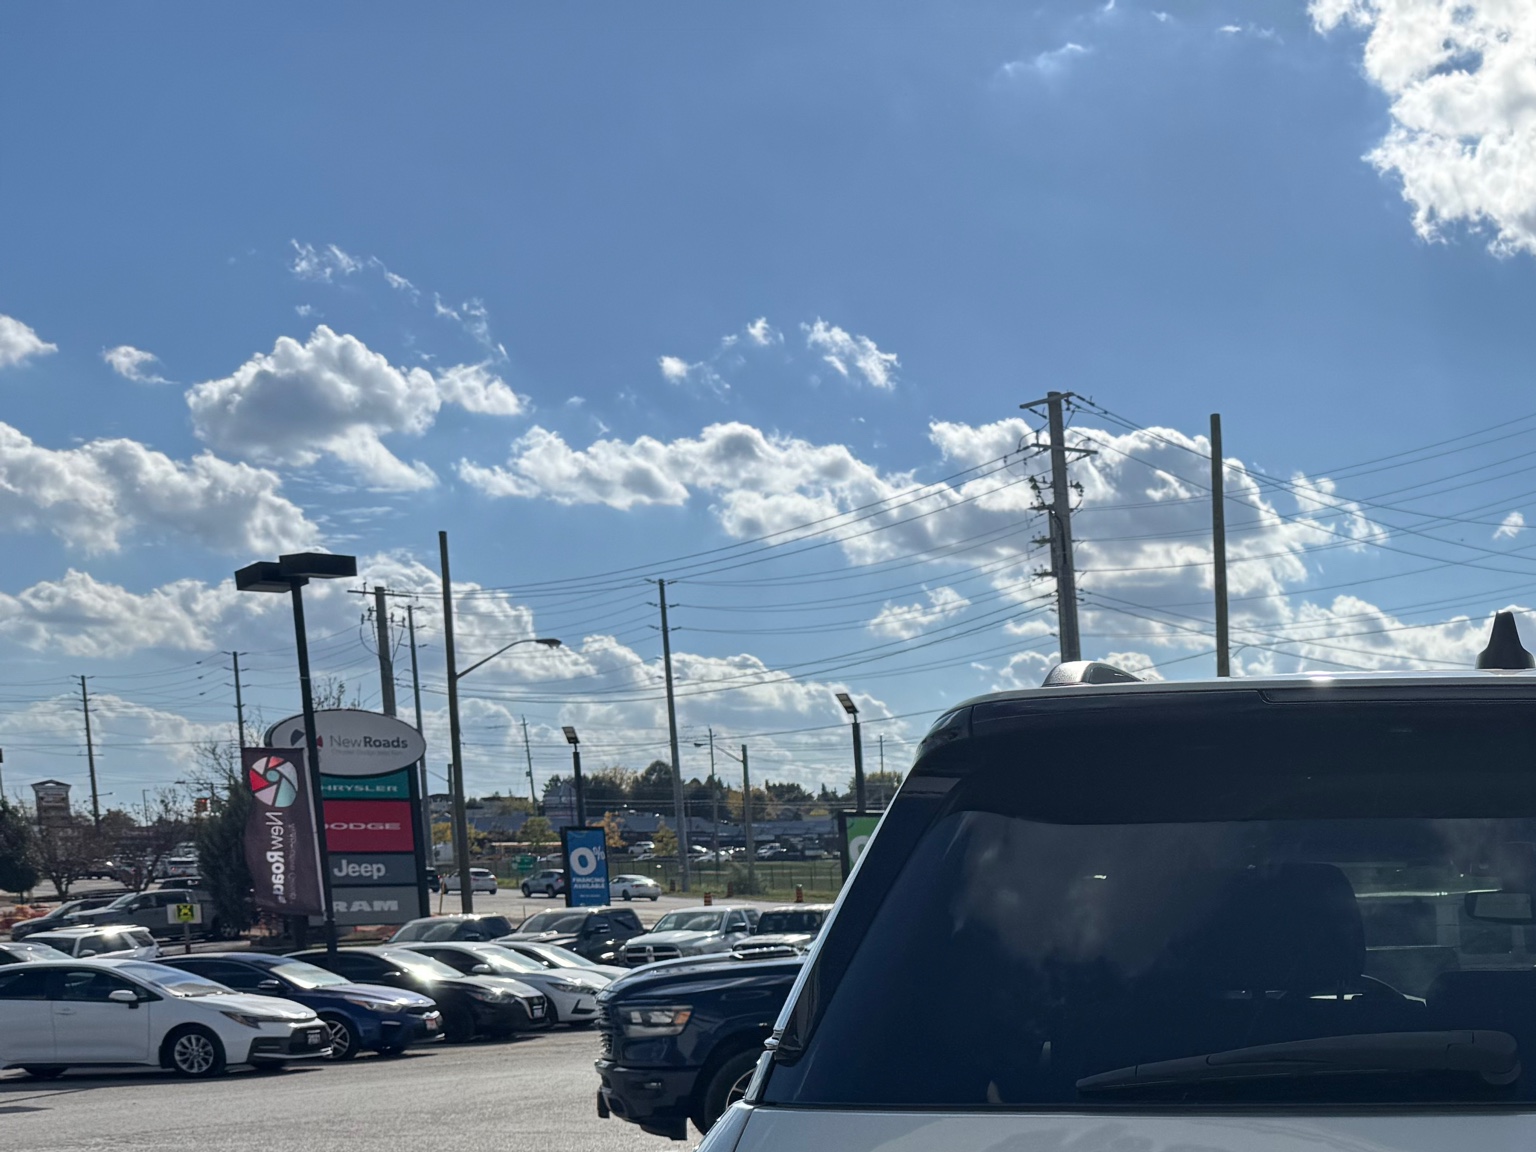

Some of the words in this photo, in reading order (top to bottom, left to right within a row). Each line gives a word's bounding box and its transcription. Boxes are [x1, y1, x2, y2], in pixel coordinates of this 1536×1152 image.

[320, 784, 398, 792] HRYSLER
[333, 859, 386, 880] Jeep
[333, 900, 399, 912] RAM
